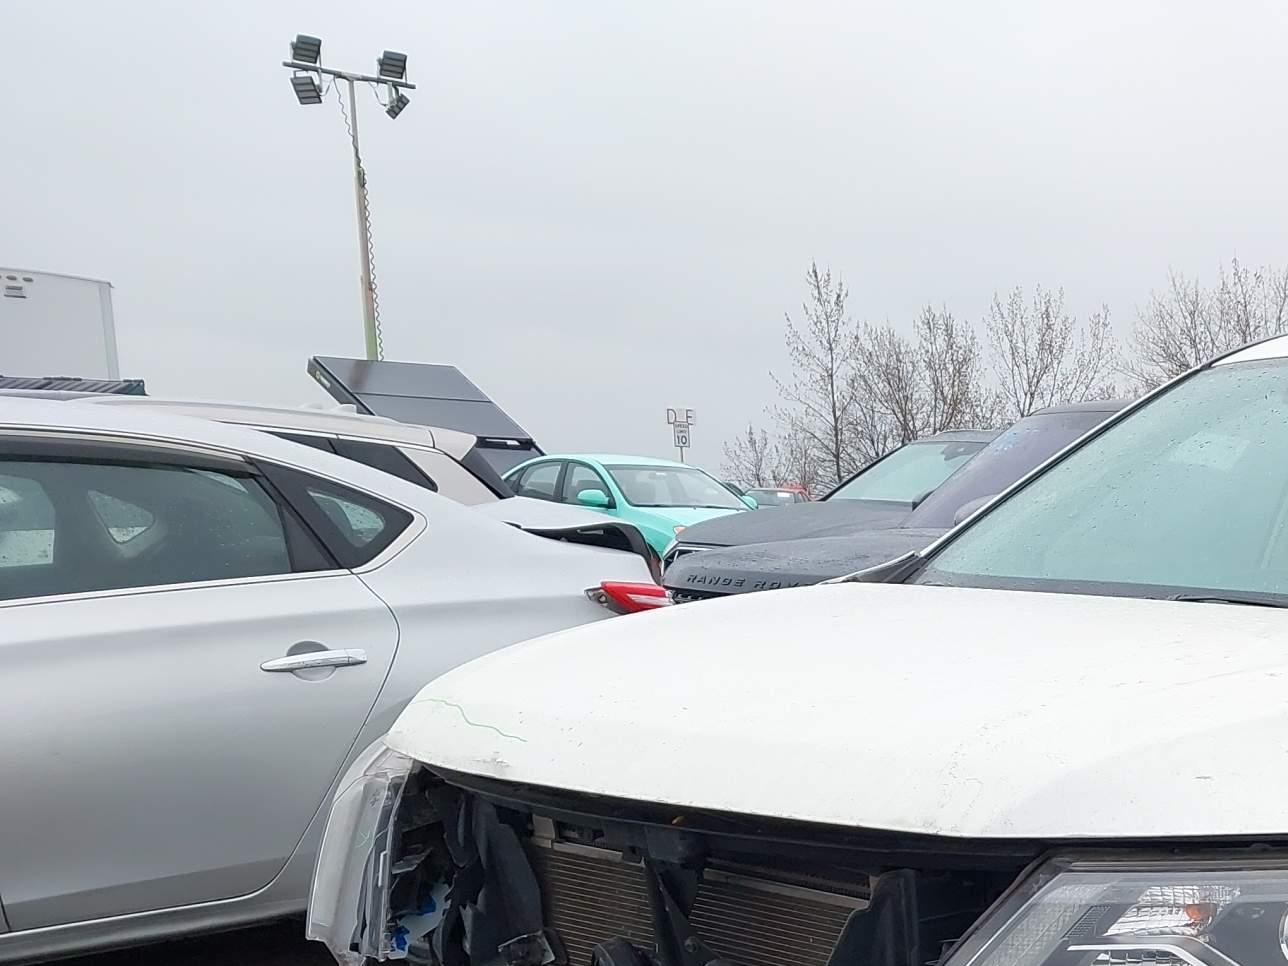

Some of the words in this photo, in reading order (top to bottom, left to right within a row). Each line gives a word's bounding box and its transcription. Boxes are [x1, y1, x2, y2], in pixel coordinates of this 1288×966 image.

[677, 435, 688, 445] 10
[687, 574, 746, 588] RANGE
[754, 580, 813, 589] ROV
